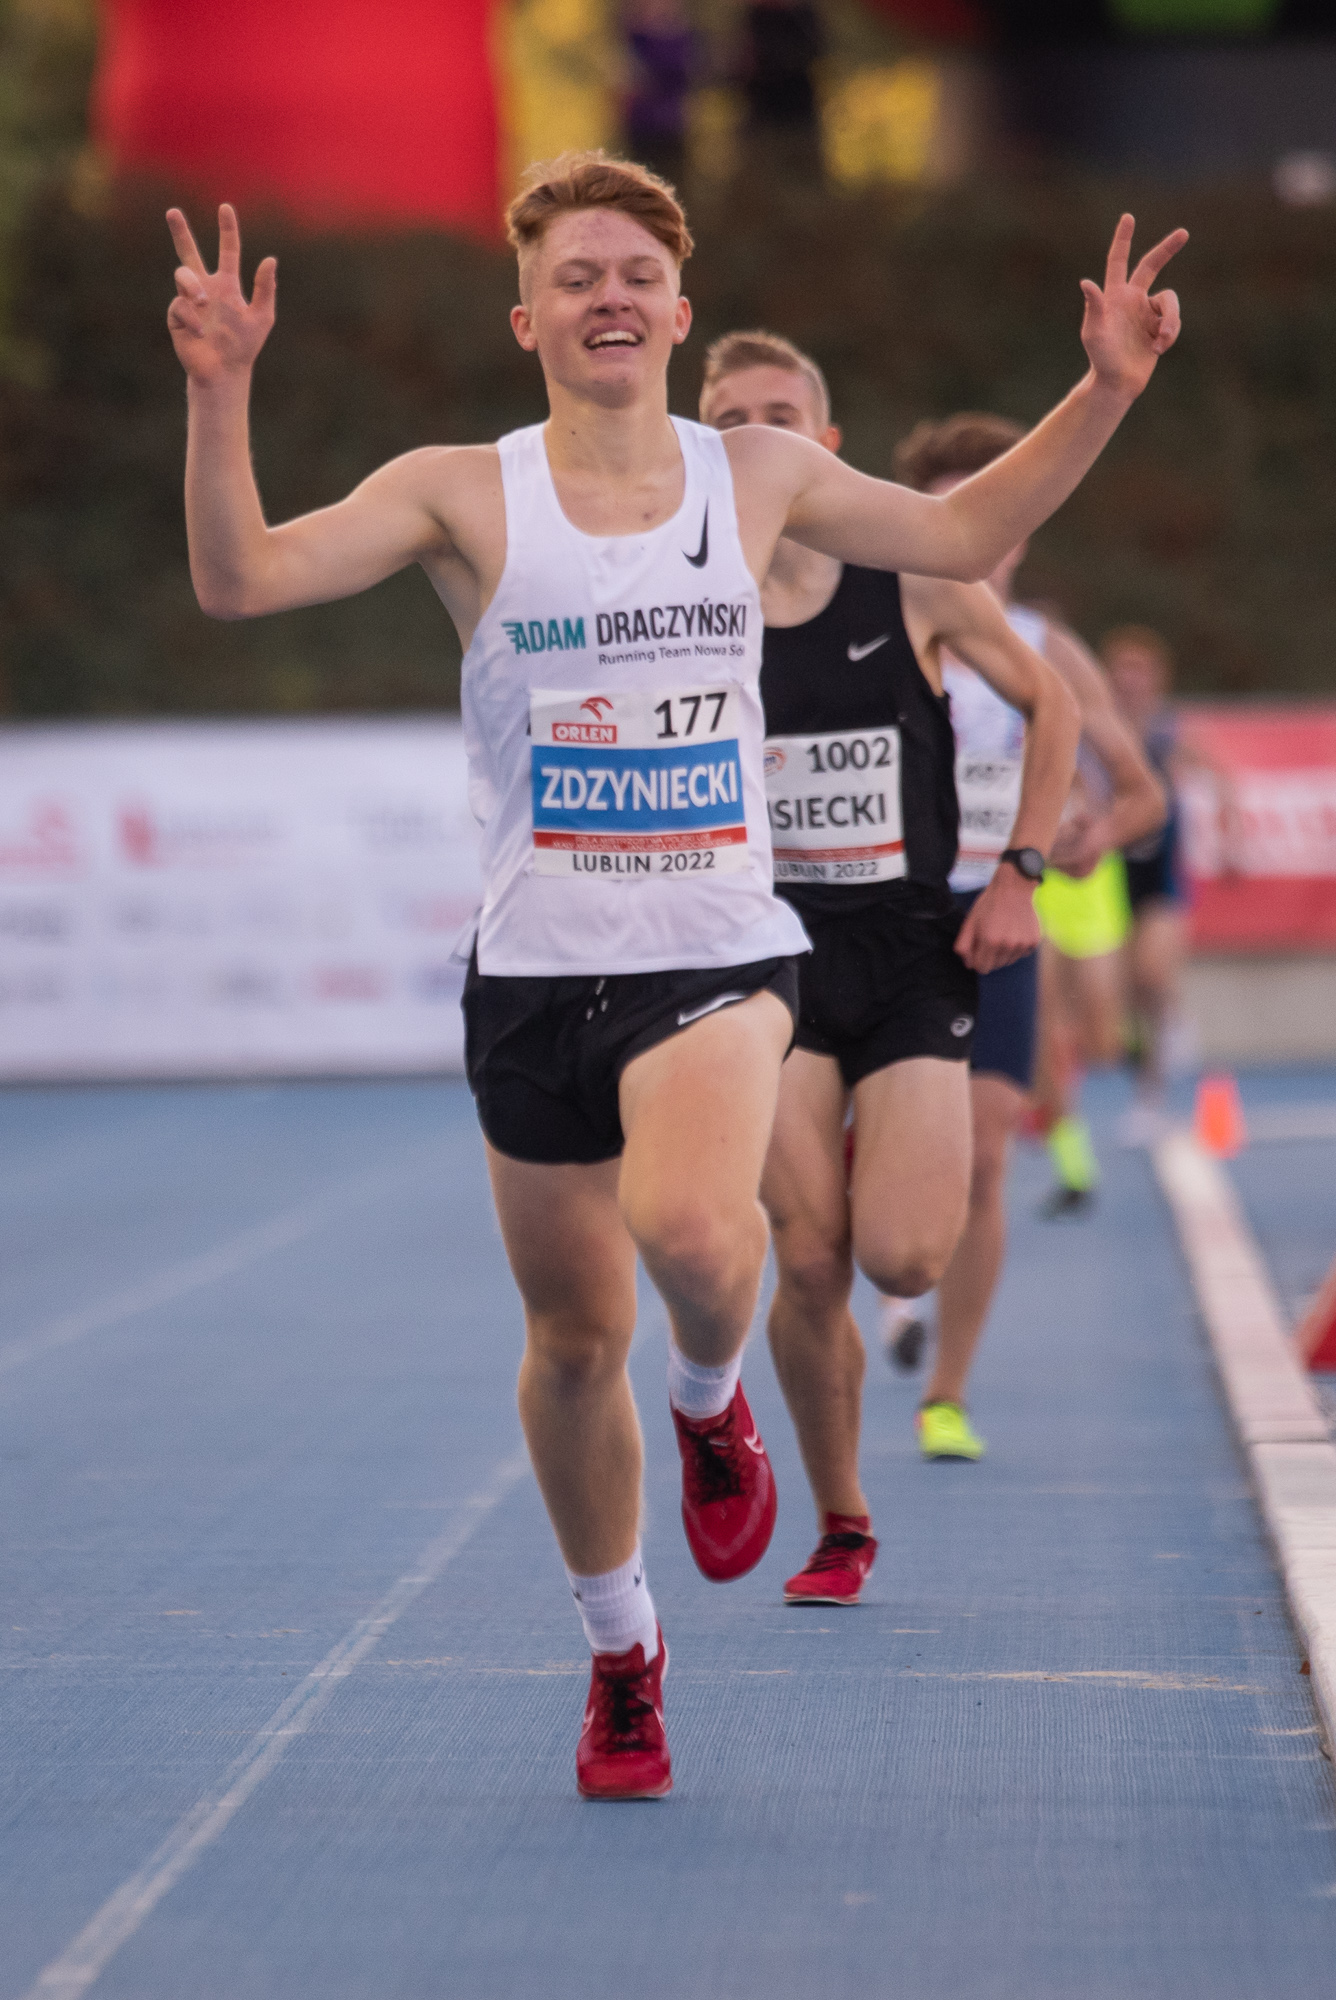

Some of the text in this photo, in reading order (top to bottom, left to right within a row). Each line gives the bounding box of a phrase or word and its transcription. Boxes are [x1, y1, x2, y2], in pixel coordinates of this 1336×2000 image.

[501, 598, 746, 654] ADAM DRACZYŃSKI
[599, 648, 655, 665] Running
[659, 645, 691, 659] Team
[694, 644, 727, 657] Nowa
[554, 725, 615, 742] ORLEN
[654, 692, 727, 739] 177
[807, 737, 891, 773] 1002
[541, 762, 738, 811] ZDZYNIECKI
[767, 794, 886, 831] SIECKI
[572, 852, 716, 873] LUBLIN 2022
[774, 861, 878, 878] UBLIN 2022
